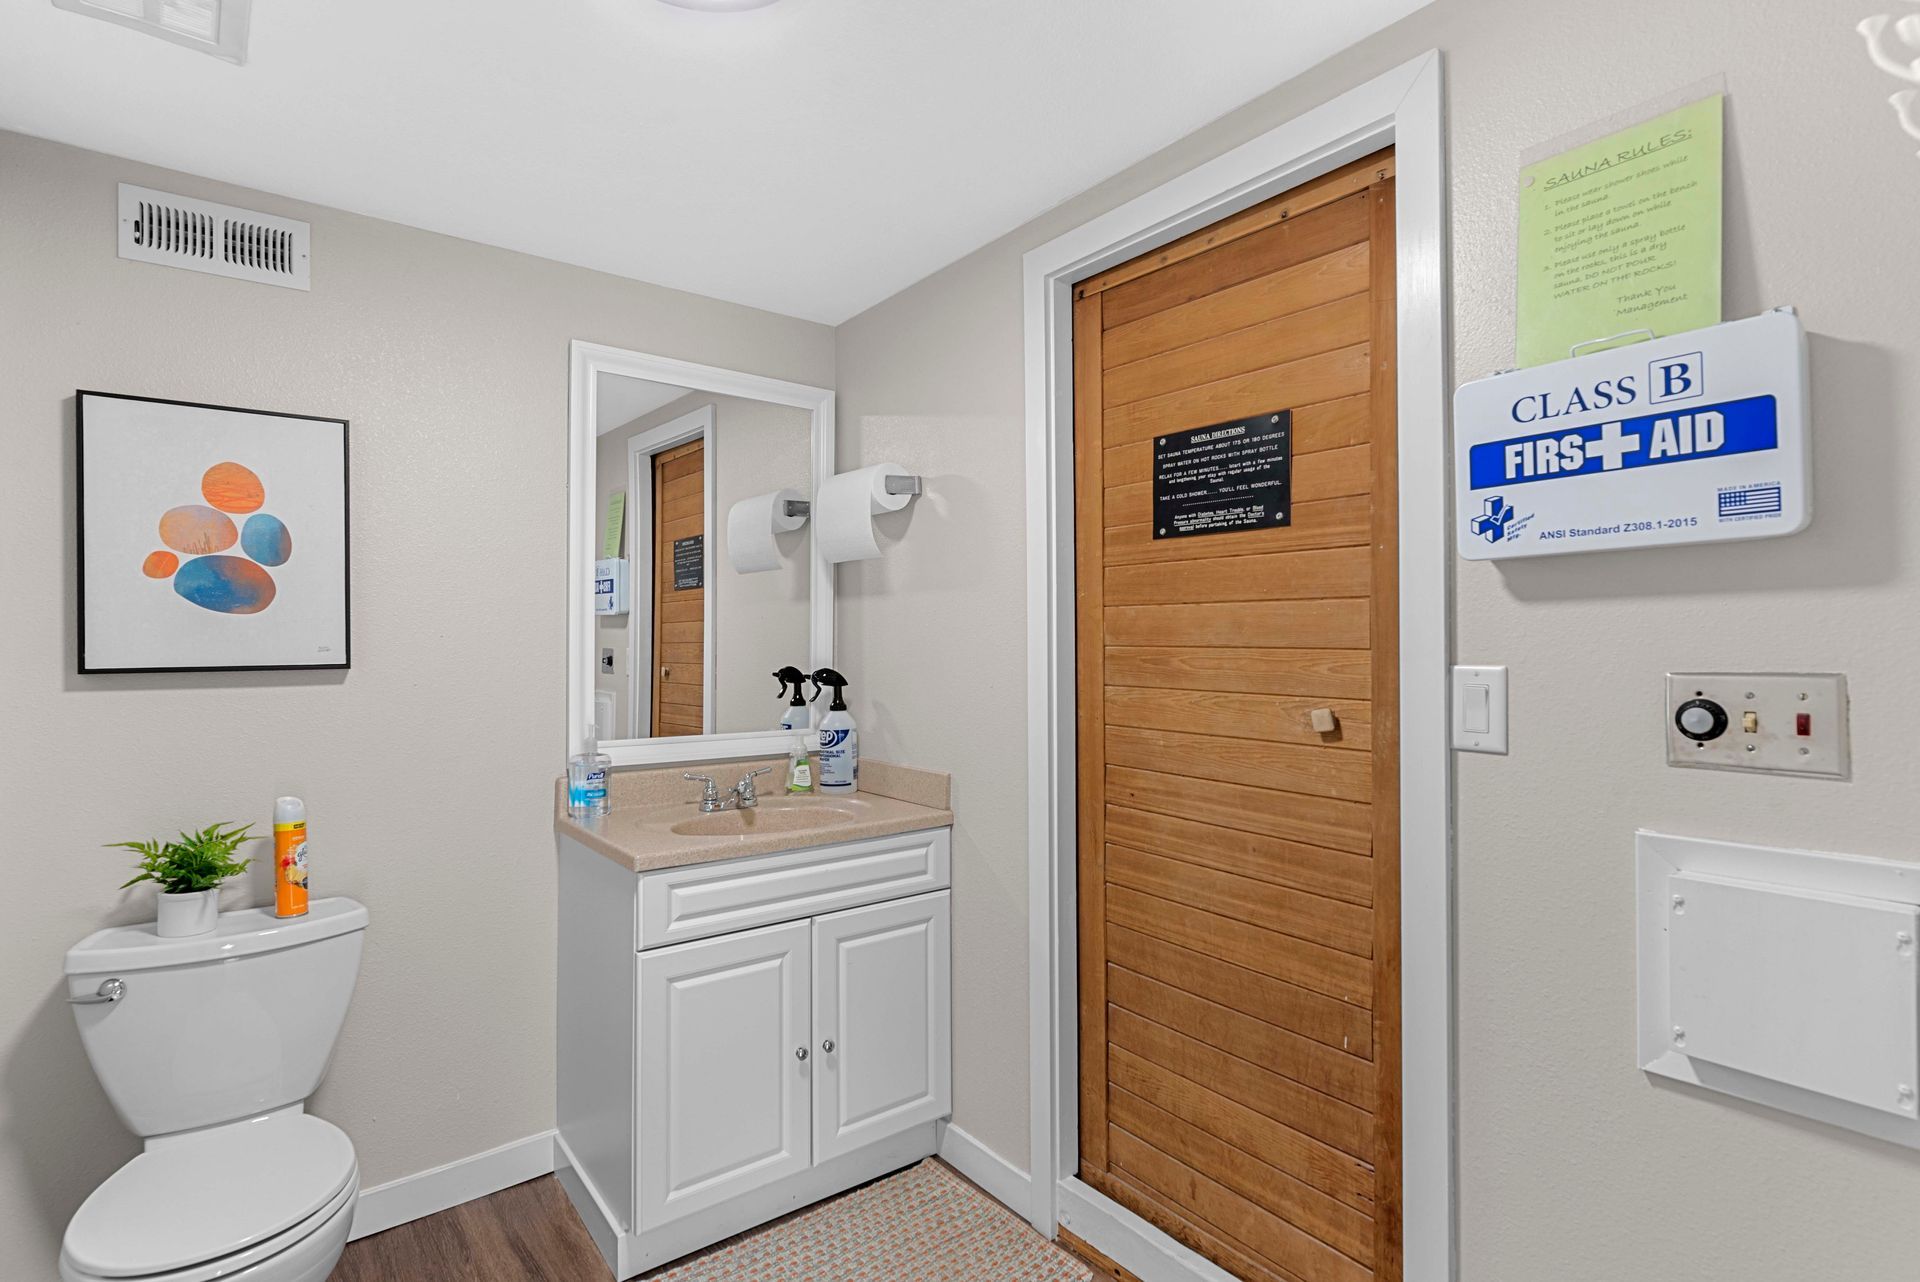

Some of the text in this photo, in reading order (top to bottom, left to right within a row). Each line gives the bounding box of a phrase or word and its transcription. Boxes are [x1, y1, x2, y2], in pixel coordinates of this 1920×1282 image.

[1545, 130, 1692, 188] SAUNA RULES:
[1554, 194, 1580, 206] Please
[1582, 187, 1600, 197] wear
[1604, 176, 1632, 189] shower
[1636, 167, 1660, 178] shoes
[1662, 155, 1688, 169] while
[1555, 220, 1580, 232] Please
[1582, 211, 1604, 224] place
[1613, 201, 1636, 212] towel
[1639, 197, 1650, 205] on
[1652, 190, 1667, 199] the
[1670, 181, 1697, 194] bench
[1567, 202, 1579, 212] the
[1565, 231, 1575, 240] sit
[1588, 223, 1604, 233] lay
[1606, 215, 1630, 225] down
[1632, 210, 1644, 218] on
[1646, 200, 1671, 212] while
[1554, 256, 1580, 268] Please
[1581, 251, 1596, 260] use
[1598, 244, 1619, 256] only
[1630, 233, 1656, 247] spray
[1659, 223, 1687, 237] bottle
[1555, 237, 1592, 253] enjoying
[1594, 230, 1608, 240] the
[1554, 272, 1565, 280] on
[1567, 266, 1580, 275] the
[1609, 253, 1628, 263] this
[1630, 248, 1638, 257] is
[1649, 239, 1667, 252] dry
[1585, 271, 1600, 280] DO
[1601, 263, 1623, 275] NOT
[1626, 255, 1656, 268] POUR
[1554, 285, 1591, 300] WATER
[1592, 279, 1608, 290] ON
[1610, 272, 1631, 283] THE
[1616, 284, 1677, 304] Thank You
[1616, 293, 1688, 317] Management
[1512, 363, 1692, 423] CLASS B
[1167, 450, 1181, 458] SAUNA
[1182, 445, 1214, 455] TEMPERATURE
[1215, 441, 1231, 449] ABOUT
[1262, 431, 1285, 441] DEGREES
[1190, 426, 1246, 445] SAUNA DIRECTIONS
[1649, 410, 1725, 459] AID
[1177, 459, 1192, 467] WATER
[1211, 453, 1227, 461] ROCKS
[1241, 448, 1257, 456] SPRAY
[1259, 444, 1279, 453] BOTTLE
[1227, 468, 1242, 476] regular
[1748, 480, 1780, 489] AMERICA
[1236, 483, 1249, 491] FEEL
[1539, 516, 1698, 542] ANSI Standard Z308.1-2015
